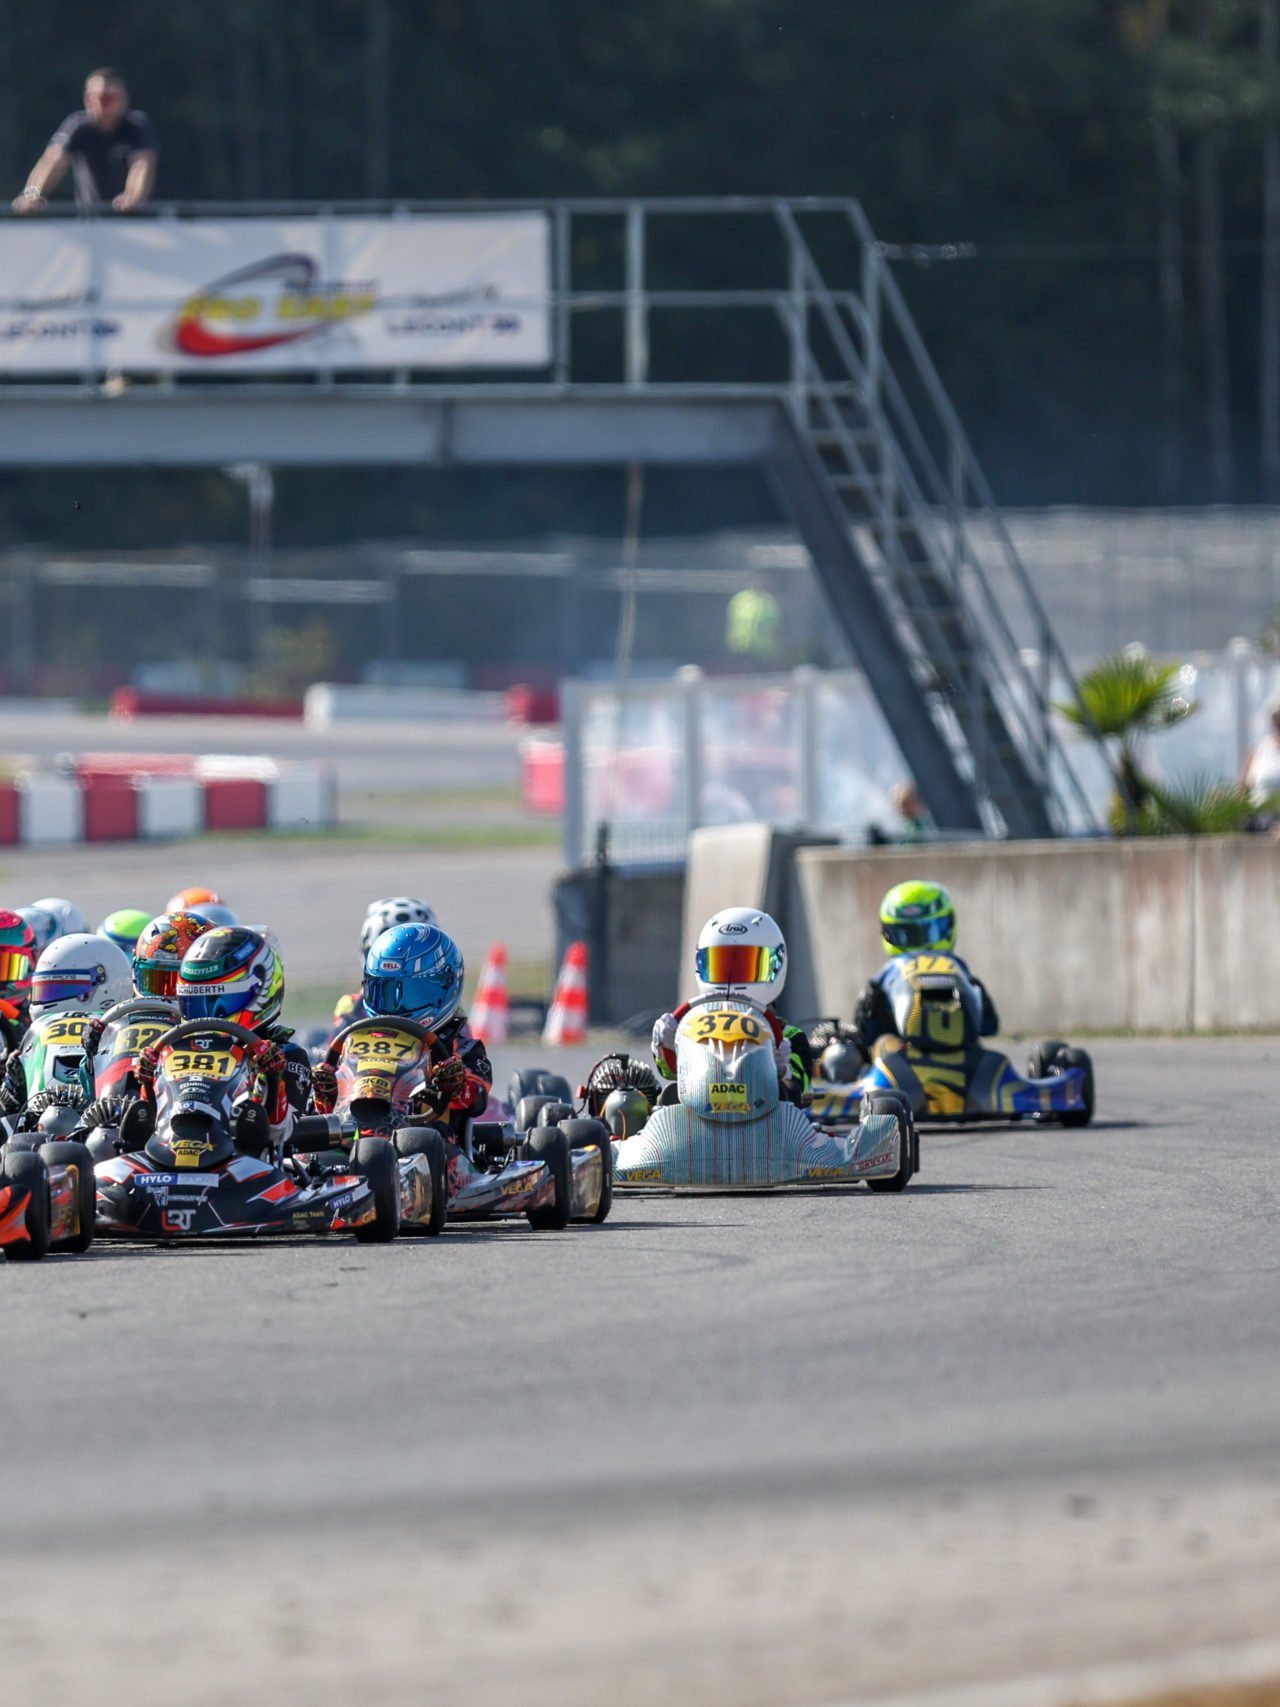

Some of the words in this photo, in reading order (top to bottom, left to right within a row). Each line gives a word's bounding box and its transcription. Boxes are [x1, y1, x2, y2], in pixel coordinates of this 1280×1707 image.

[722, 924, 744, 932] Arai
[47, 1022, 87, 1040] 30
[697, 1013, 761, 1038] 370
[120, 1028, 168, 1051] 32
[352, 1041, 417, 1058] 387
[170, 1054, 230, 1074] 381
[712, 1085, 745, 1093] ADAC
[170, 1140, 213, 1151] VEGA
[626, 1169, 662, 1181] VEGA
[808, 1168, 843, 1177] VEGA
[140, 1175, 172, 1184] HYLO
[500, 1182, 534, 1196] VEGA
[332, 1195, 352, 1208] HYLO
